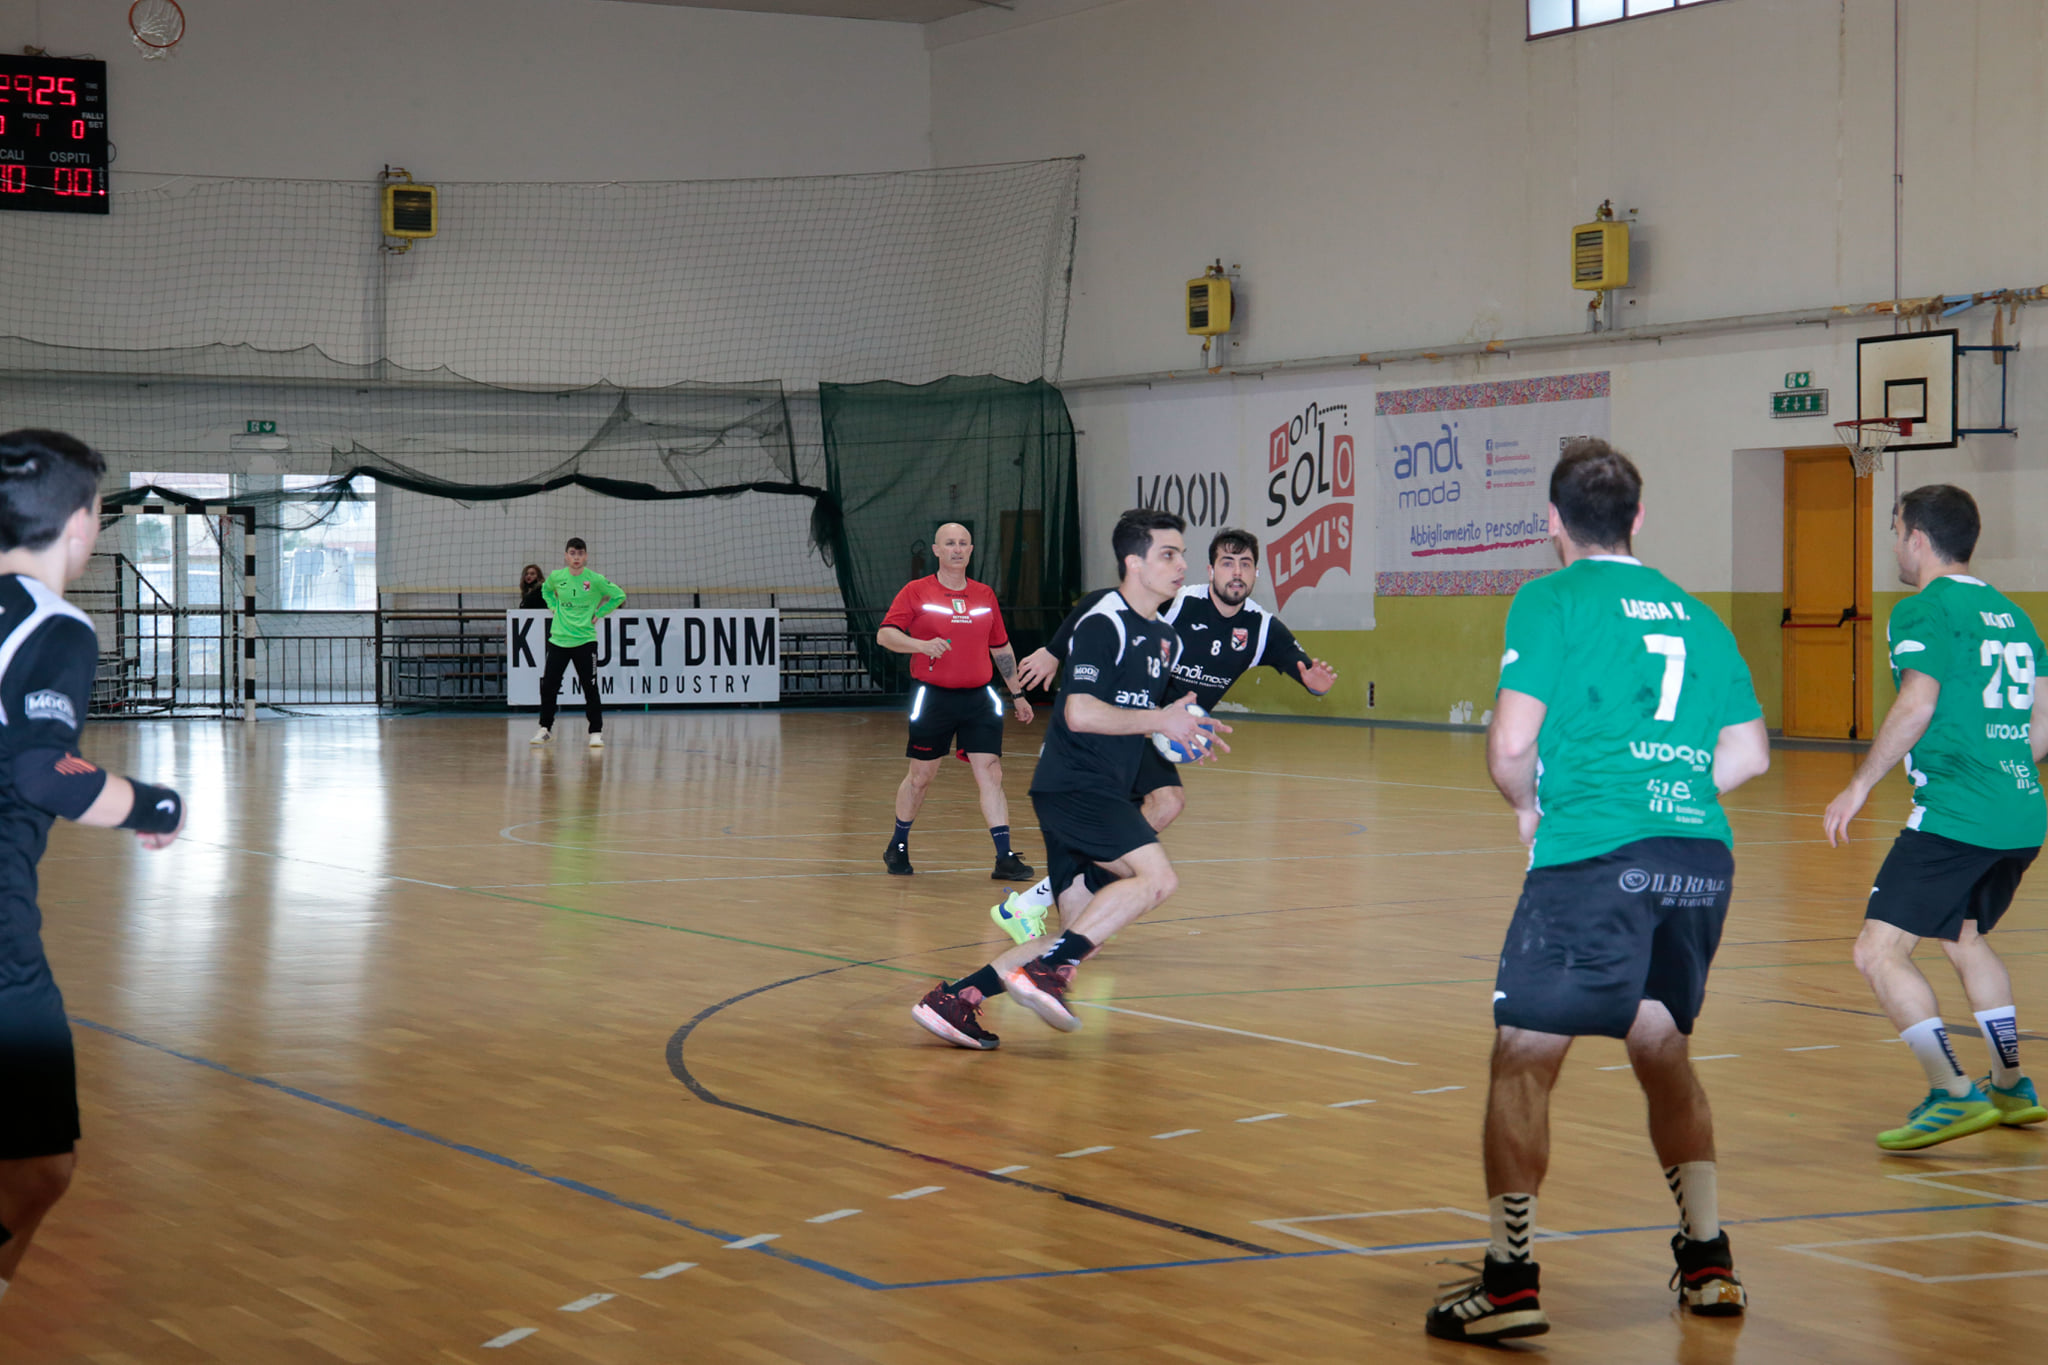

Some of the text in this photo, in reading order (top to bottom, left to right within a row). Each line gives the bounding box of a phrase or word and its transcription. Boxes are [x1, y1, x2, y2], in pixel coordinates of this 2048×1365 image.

[72, 120, 85, 139] 0
[50, 152, 90, 164] OSPITI
[1394, 422, 1463, 480] andi
[1399, 480, 1461, 510] moda
[1410, 520, 1481, 548] Abbigliamento
[1275, 515, 1350, 587] LEVI'S
[1620, 598, 1673, 620] LAERA
[685, 617, 775, 667] DNM
[1210, 639, 1222, 656] 8
[1147, 656, 1161, 678] 18
[1643, 634, 1686, 722] 7
[1980, 639, 2035, 710] 29
[630, 675, 752, 695] INDUSTRY
